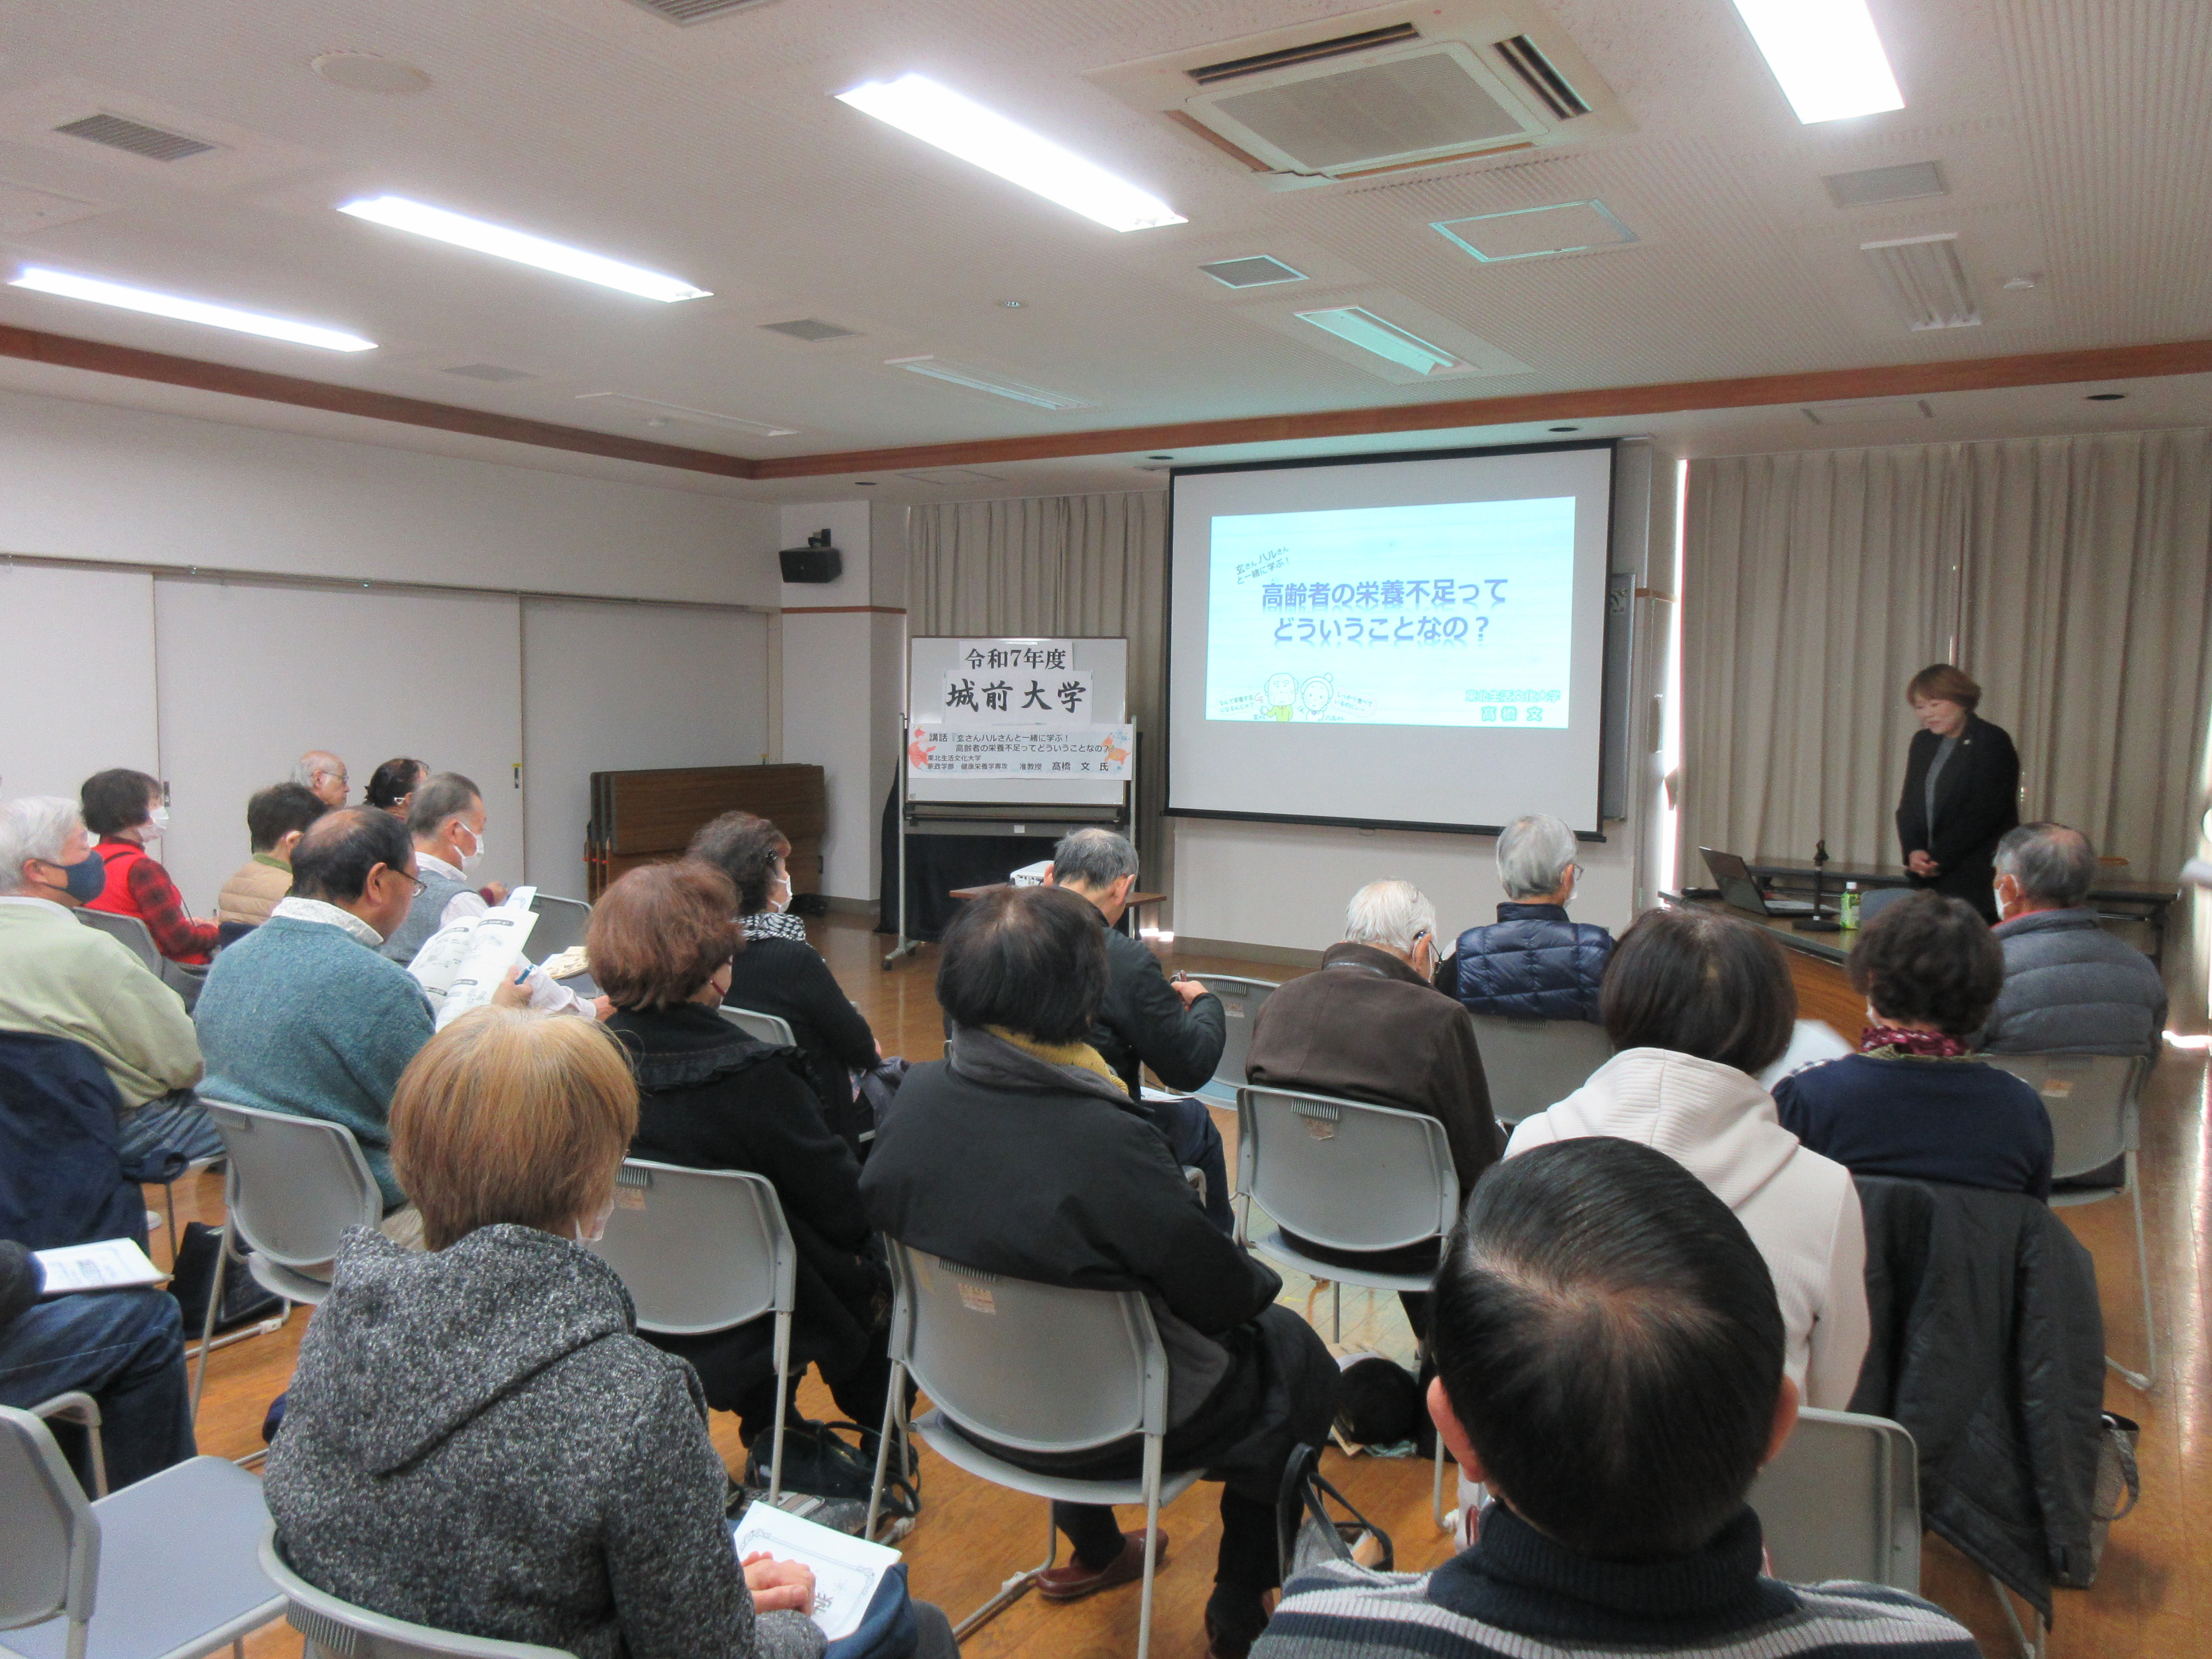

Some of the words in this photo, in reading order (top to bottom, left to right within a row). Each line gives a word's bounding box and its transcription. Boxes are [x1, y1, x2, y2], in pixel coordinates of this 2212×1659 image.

[1237, 556, 1290, 585] と一緒に学ぶ！
[1262, 579, 1508, 607] 高齢者の栄養不足って
[1274, 617, 1489, 640] どういうことなの？
[965, 647, 1066, 670] 令和7年度
[946, 678, 1086, 713] 城前大学
[1465, 690, 1560, 702] 東北生活文化大学
[1526, 706, 1543, 721] 文
[1080, 762, 1090, 771] 文
[1099, 762, 1109, 771] 氏
